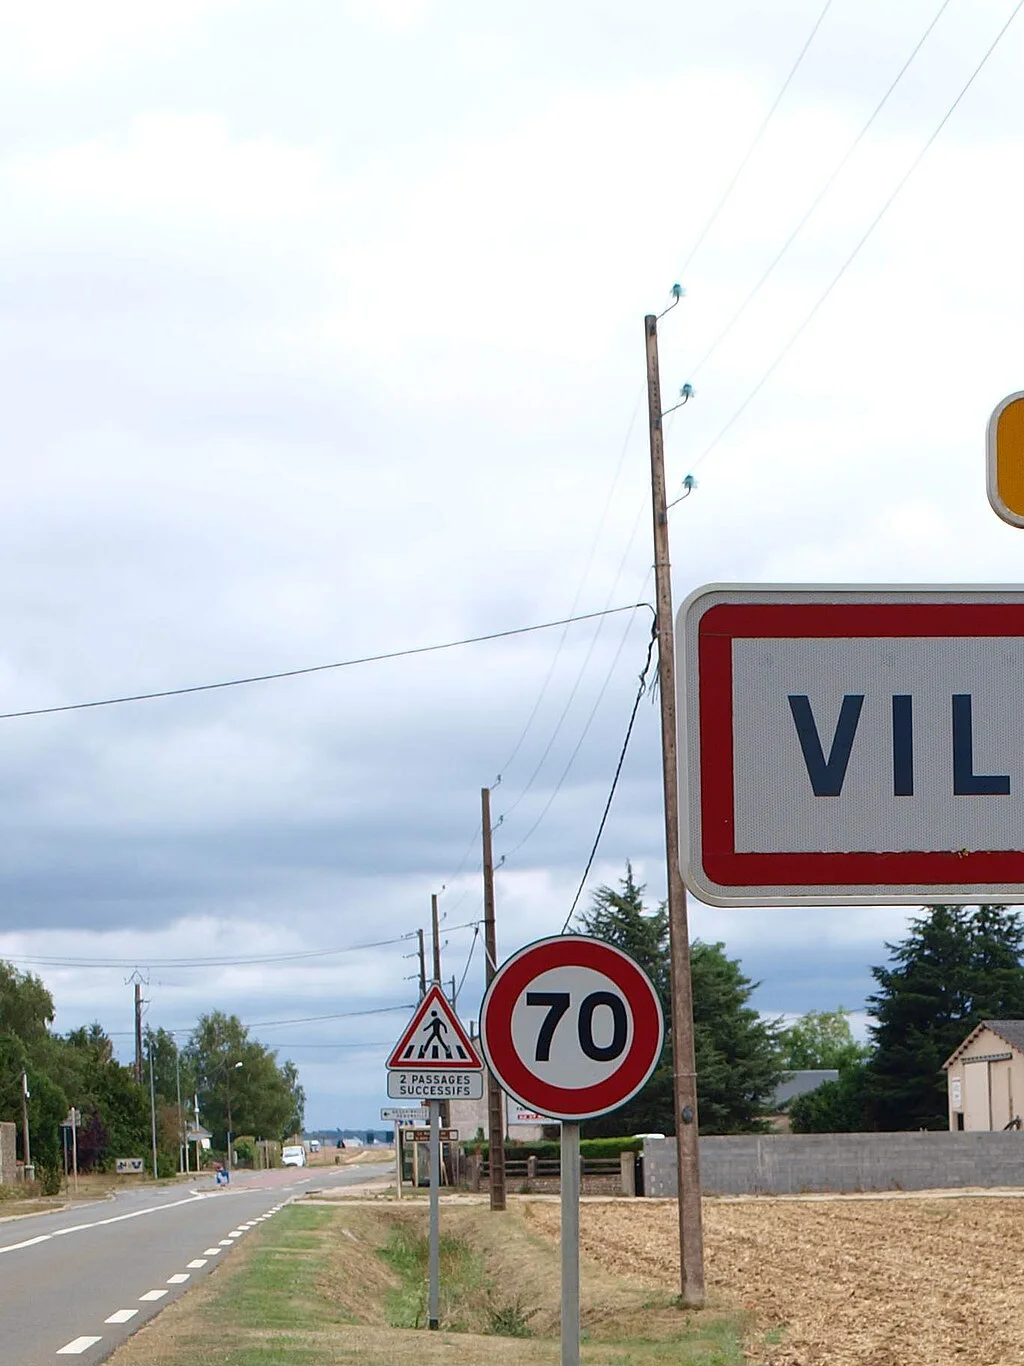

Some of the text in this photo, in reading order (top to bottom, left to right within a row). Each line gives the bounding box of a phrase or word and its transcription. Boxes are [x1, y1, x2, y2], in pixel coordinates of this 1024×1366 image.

[526, 991, 628, 1062] 70
[400, 1075, 471, 1085] 2 PASSAGES
[400, 1086, 471, 1096] SUCCESSIFS
